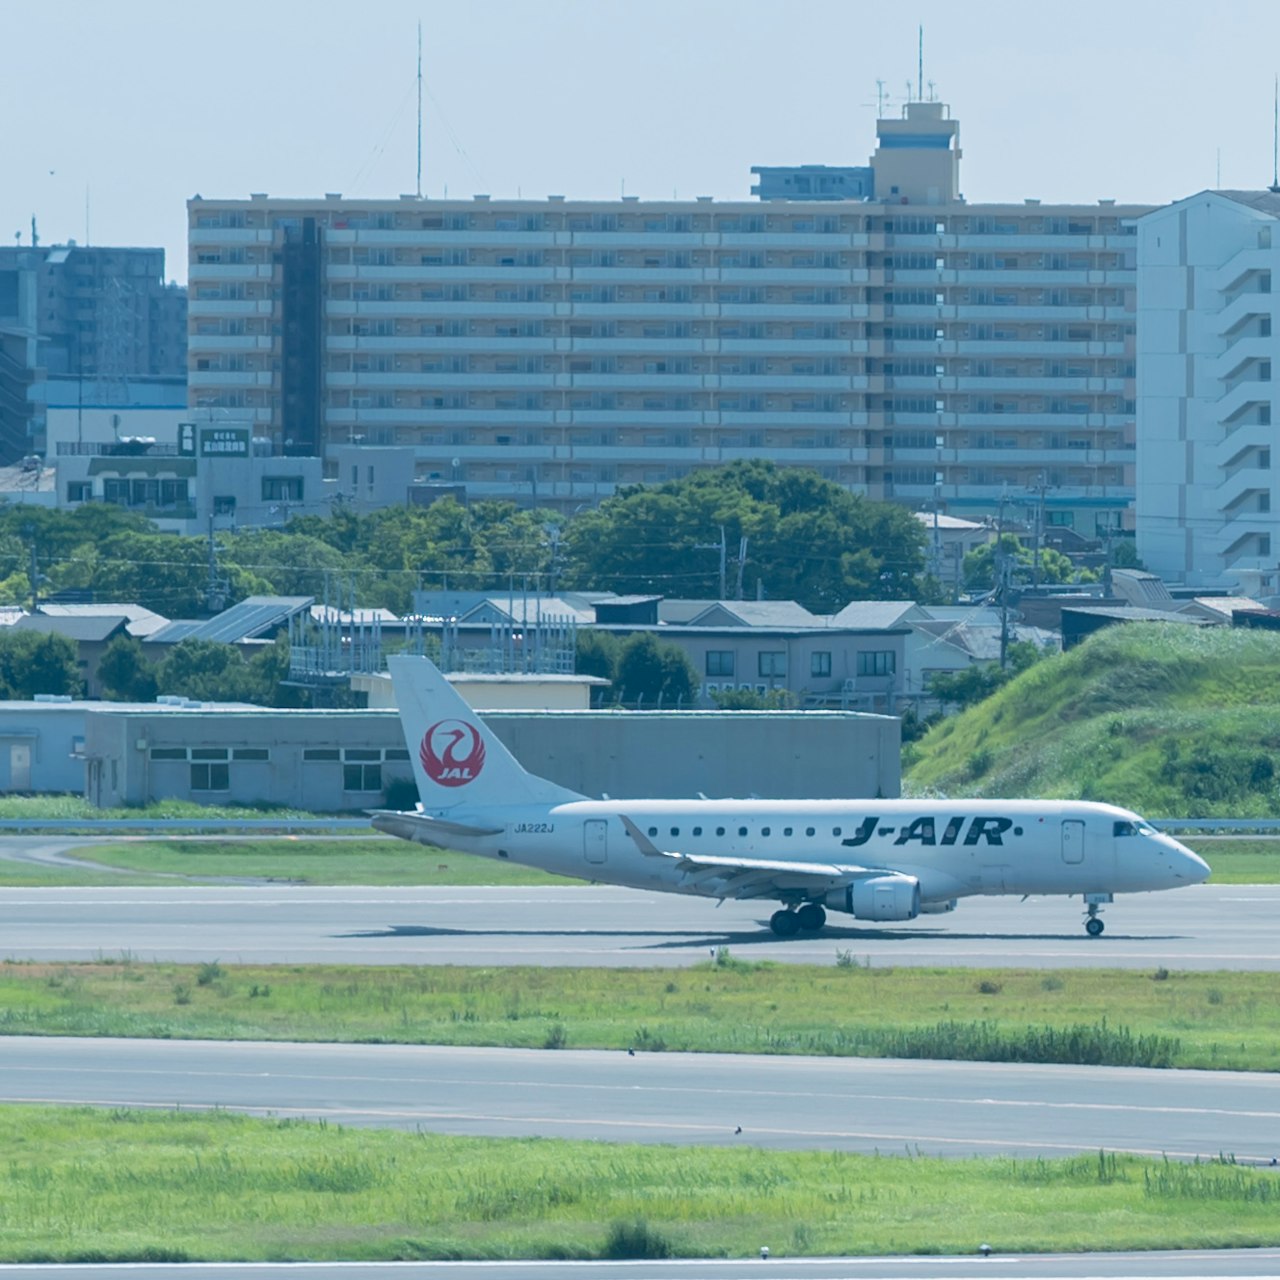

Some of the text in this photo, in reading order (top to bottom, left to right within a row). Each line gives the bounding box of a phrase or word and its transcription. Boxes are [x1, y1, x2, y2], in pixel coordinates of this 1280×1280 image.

[438, 768, 472, 780] JAL
[515, 824, 553, 833] JA222J
[841, 816, 1013, 847] J-AIR
